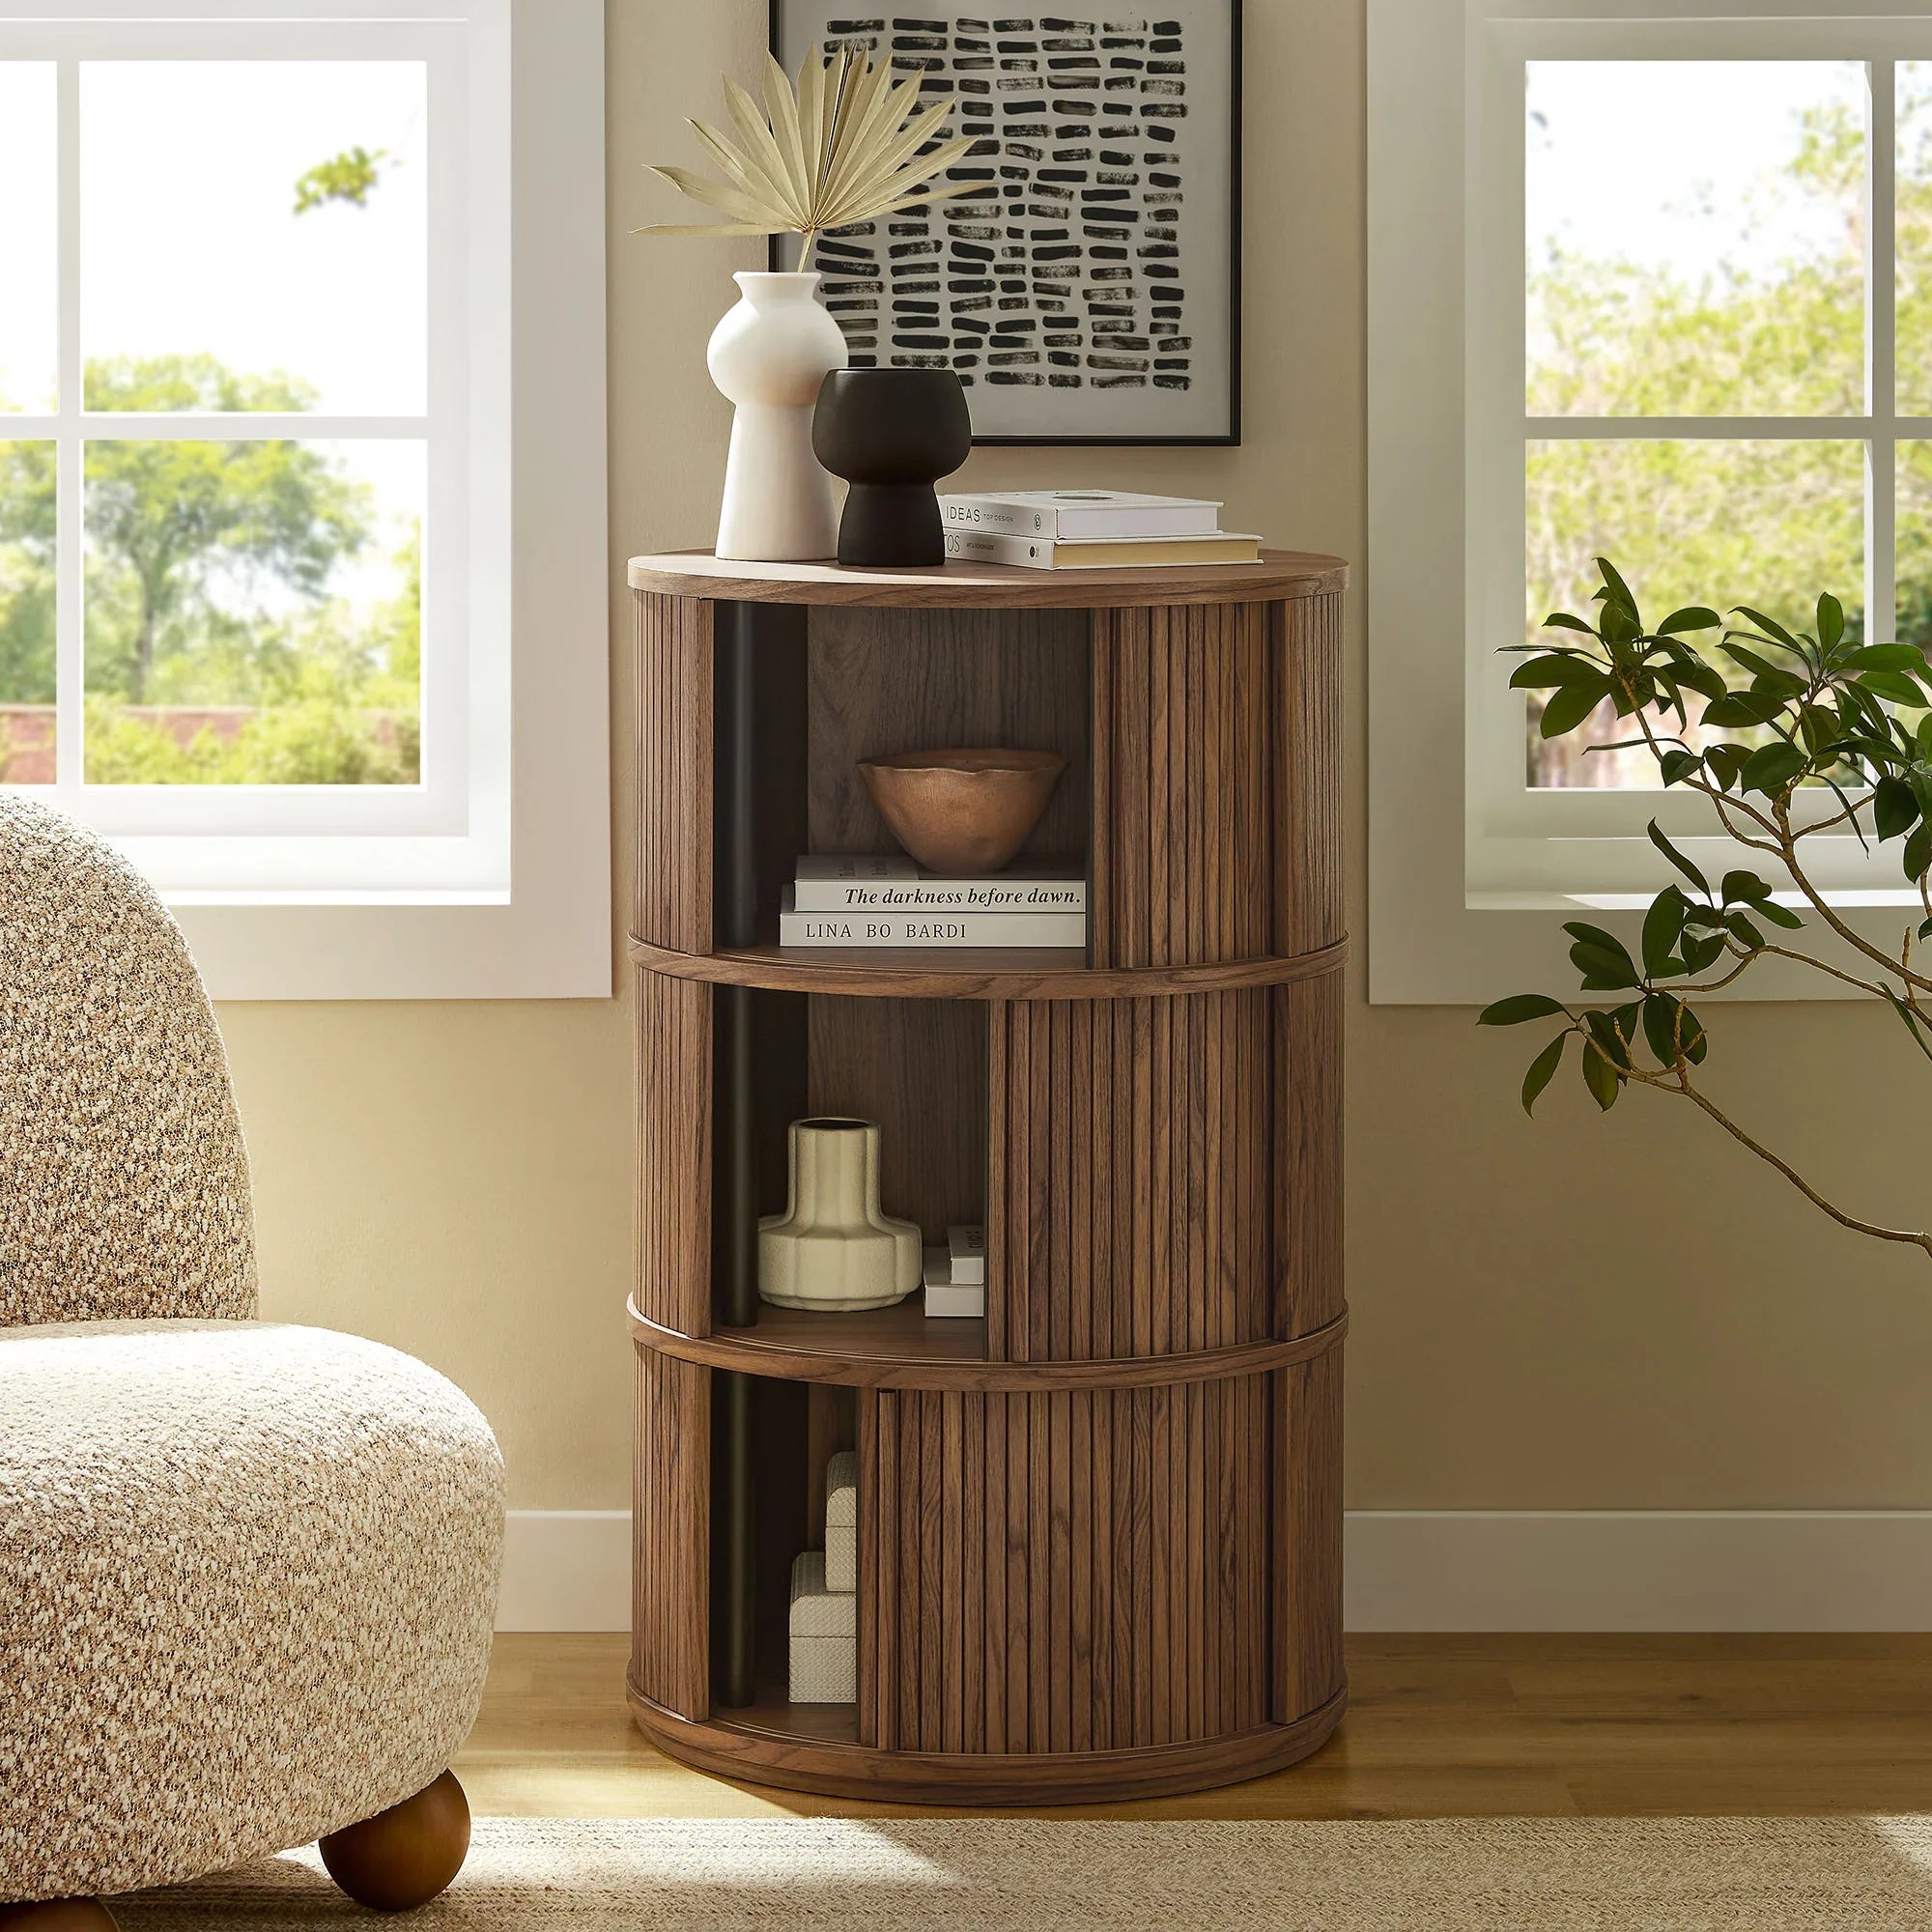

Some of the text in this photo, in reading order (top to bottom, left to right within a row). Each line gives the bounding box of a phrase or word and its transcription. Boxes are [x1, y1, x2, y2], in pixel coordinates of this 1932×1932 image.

[946, 506, 980, 523] IDEAS
[845, 888, 1081, 907] The darkness before dawn.
[806, 923, 966, 938] LINA BO BARDI
